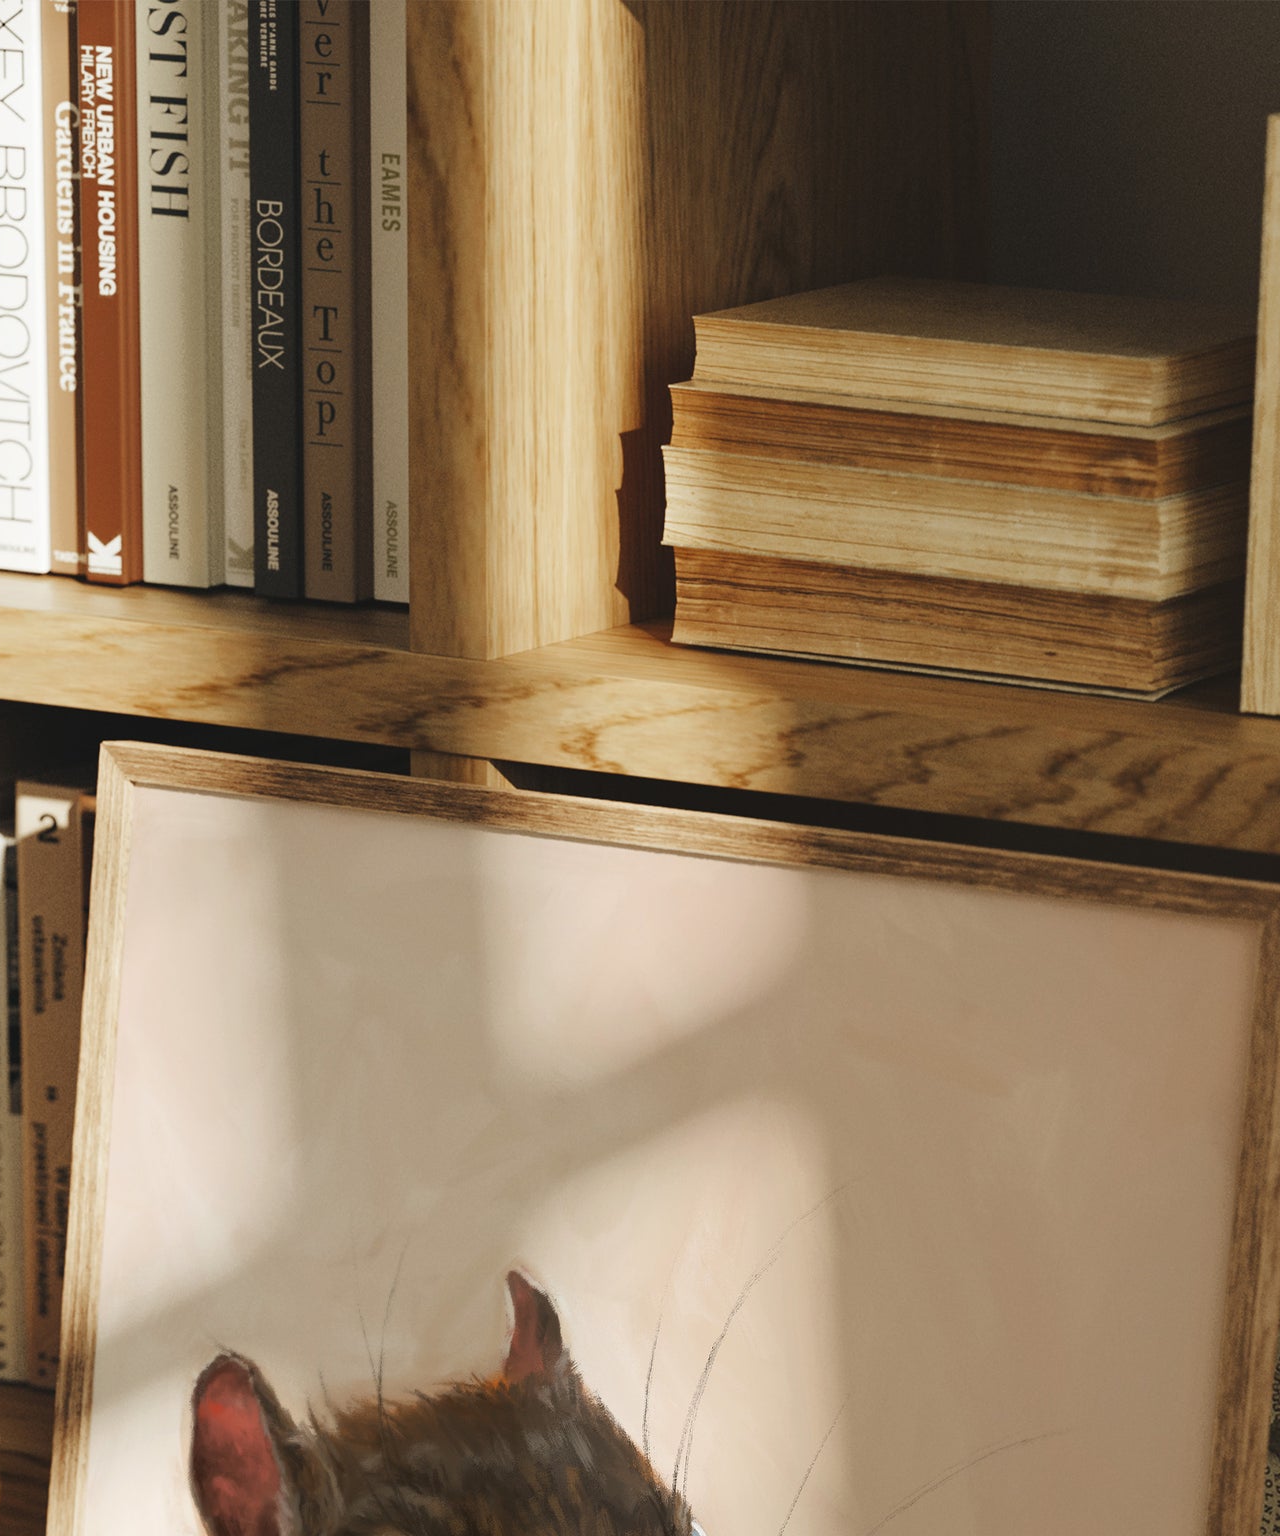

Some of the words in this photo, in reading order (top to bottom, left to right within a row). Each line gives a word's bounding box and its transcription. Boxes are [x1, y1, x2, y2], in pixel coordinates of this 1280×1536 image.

[80, 44, 96, 101] HILARY
[95, 44, 114, 99] NEW
[53, 100, 81, 234] Gardens
[81, 106, 98, 179] FRENCH
[95, 104, 116, 182] URBAN
[148, 92, 191, 222] FISH
[380, 152, 401, 233] EAMES
[57, 240, 80, 273] in
[97, 188, 119, 298] HOUSING
[256, 199, 285, 370] BORDEAUX
[56, 281, 83, 393] France
[166, 484, 181, 560] ASSOULINE
[266, 489, 281, 572] ASSOULINE
[321, 491, 334, 572] ASSOULINE
[385, 499, 399, 579] ASSOULINE
[37, 814, 60, 844] 2
